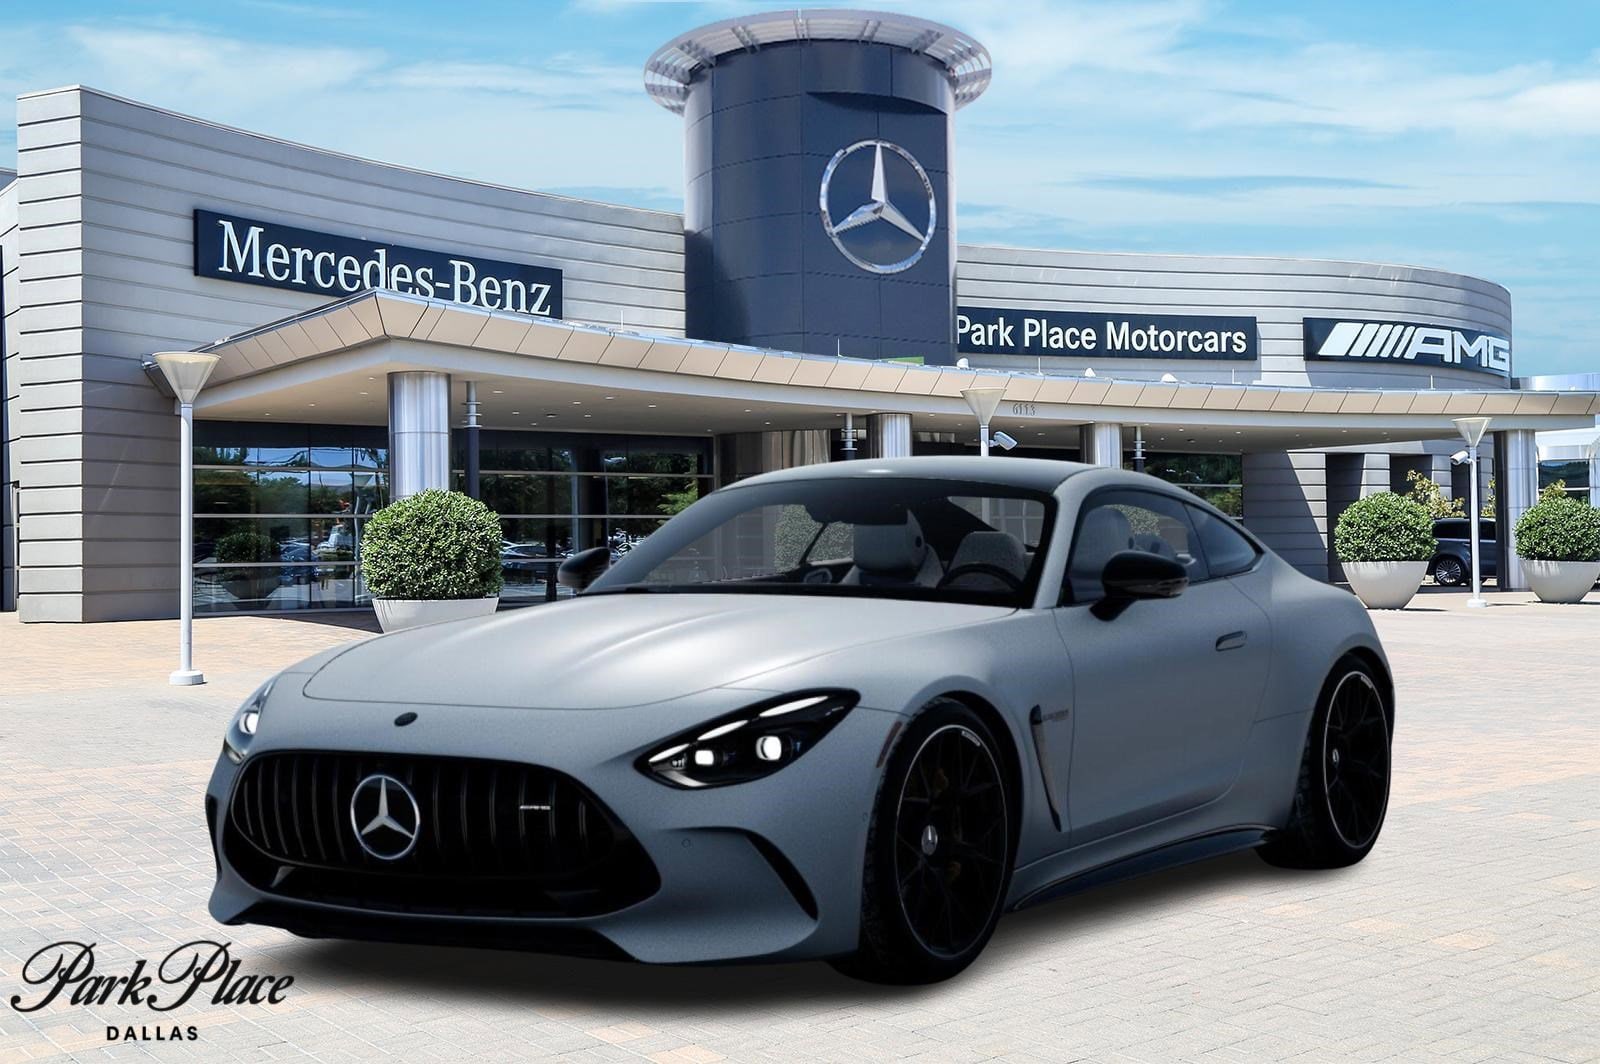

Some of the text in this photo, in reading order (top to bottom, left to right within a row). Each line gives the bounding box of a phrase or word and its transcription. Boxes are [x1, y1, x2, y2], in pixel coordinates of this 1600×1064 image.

[218, 219, 552, 316] Mercedes-Benz
[957, 314, 1248, 353] Park Place Motorcars
[1403, 326, 1510, 373] AMG
[1012, 402, 1036, 416] 6113
